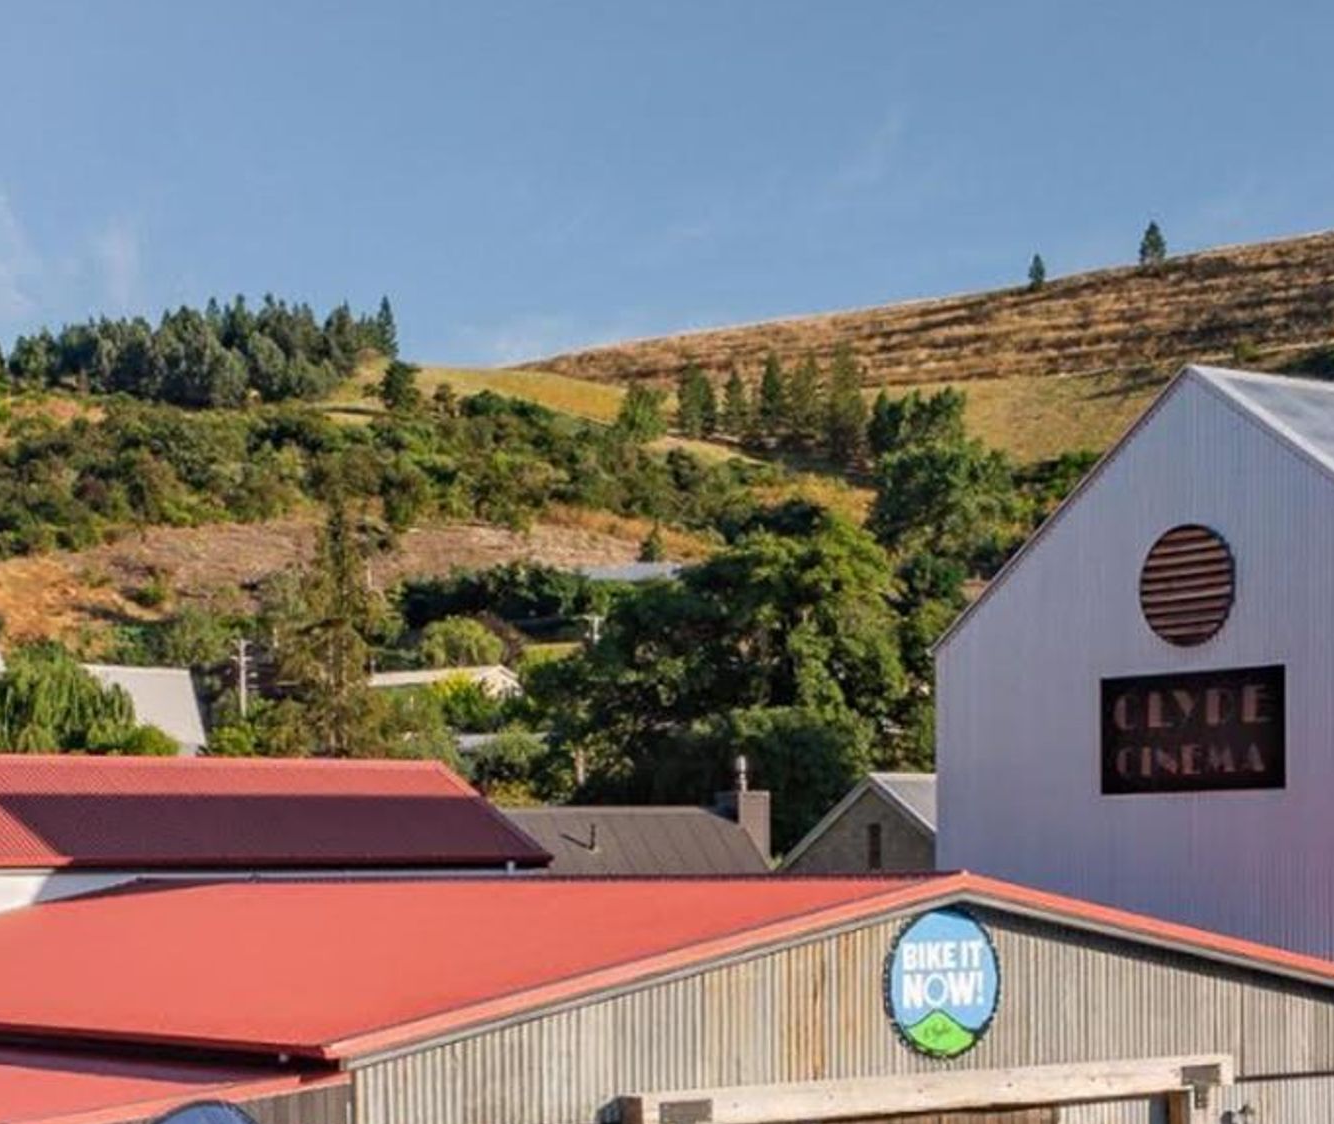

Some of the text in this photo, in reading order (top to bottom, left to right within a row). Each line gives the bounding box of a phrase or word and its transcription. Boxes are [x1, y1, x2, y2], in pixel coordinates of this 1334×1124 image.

[1114, 684, 1272, 730] CLYDE
[1116, 743, 1266, 776] CINEMA
[902, 939, 983, 970] BIKE IT
[902, 971, 984, 1009] NOW!
